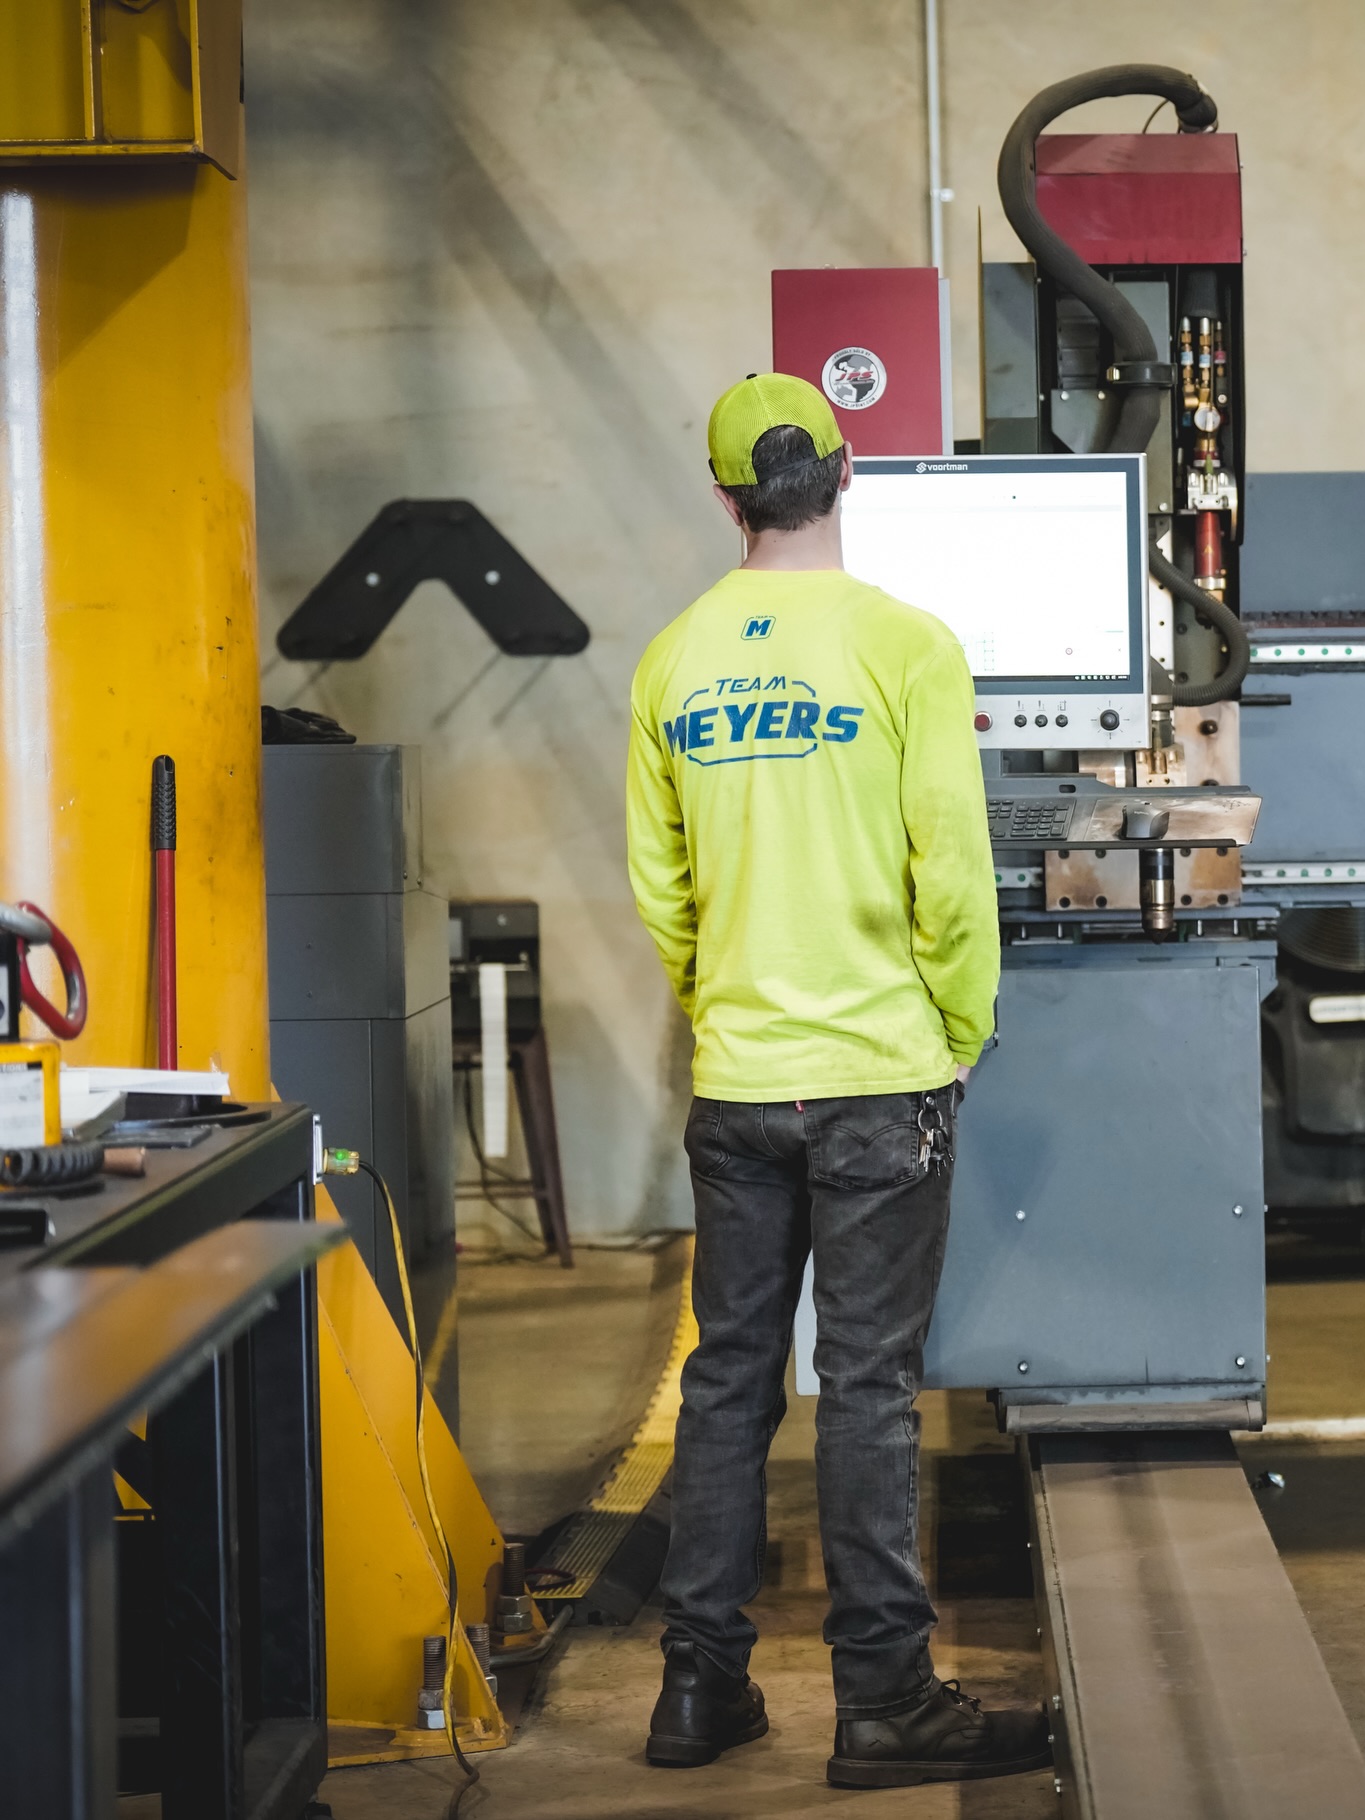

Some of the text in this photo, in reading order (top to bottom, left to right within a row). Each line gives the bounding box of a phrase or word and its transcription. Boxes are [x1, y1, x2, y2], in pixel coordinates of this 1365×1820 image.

[927, 463, 968, 471] voortman
[745, 619, 771, 637] M
[716, 676, 786, 696] TEAM
[663, 701, 864, 758] MEYERS
